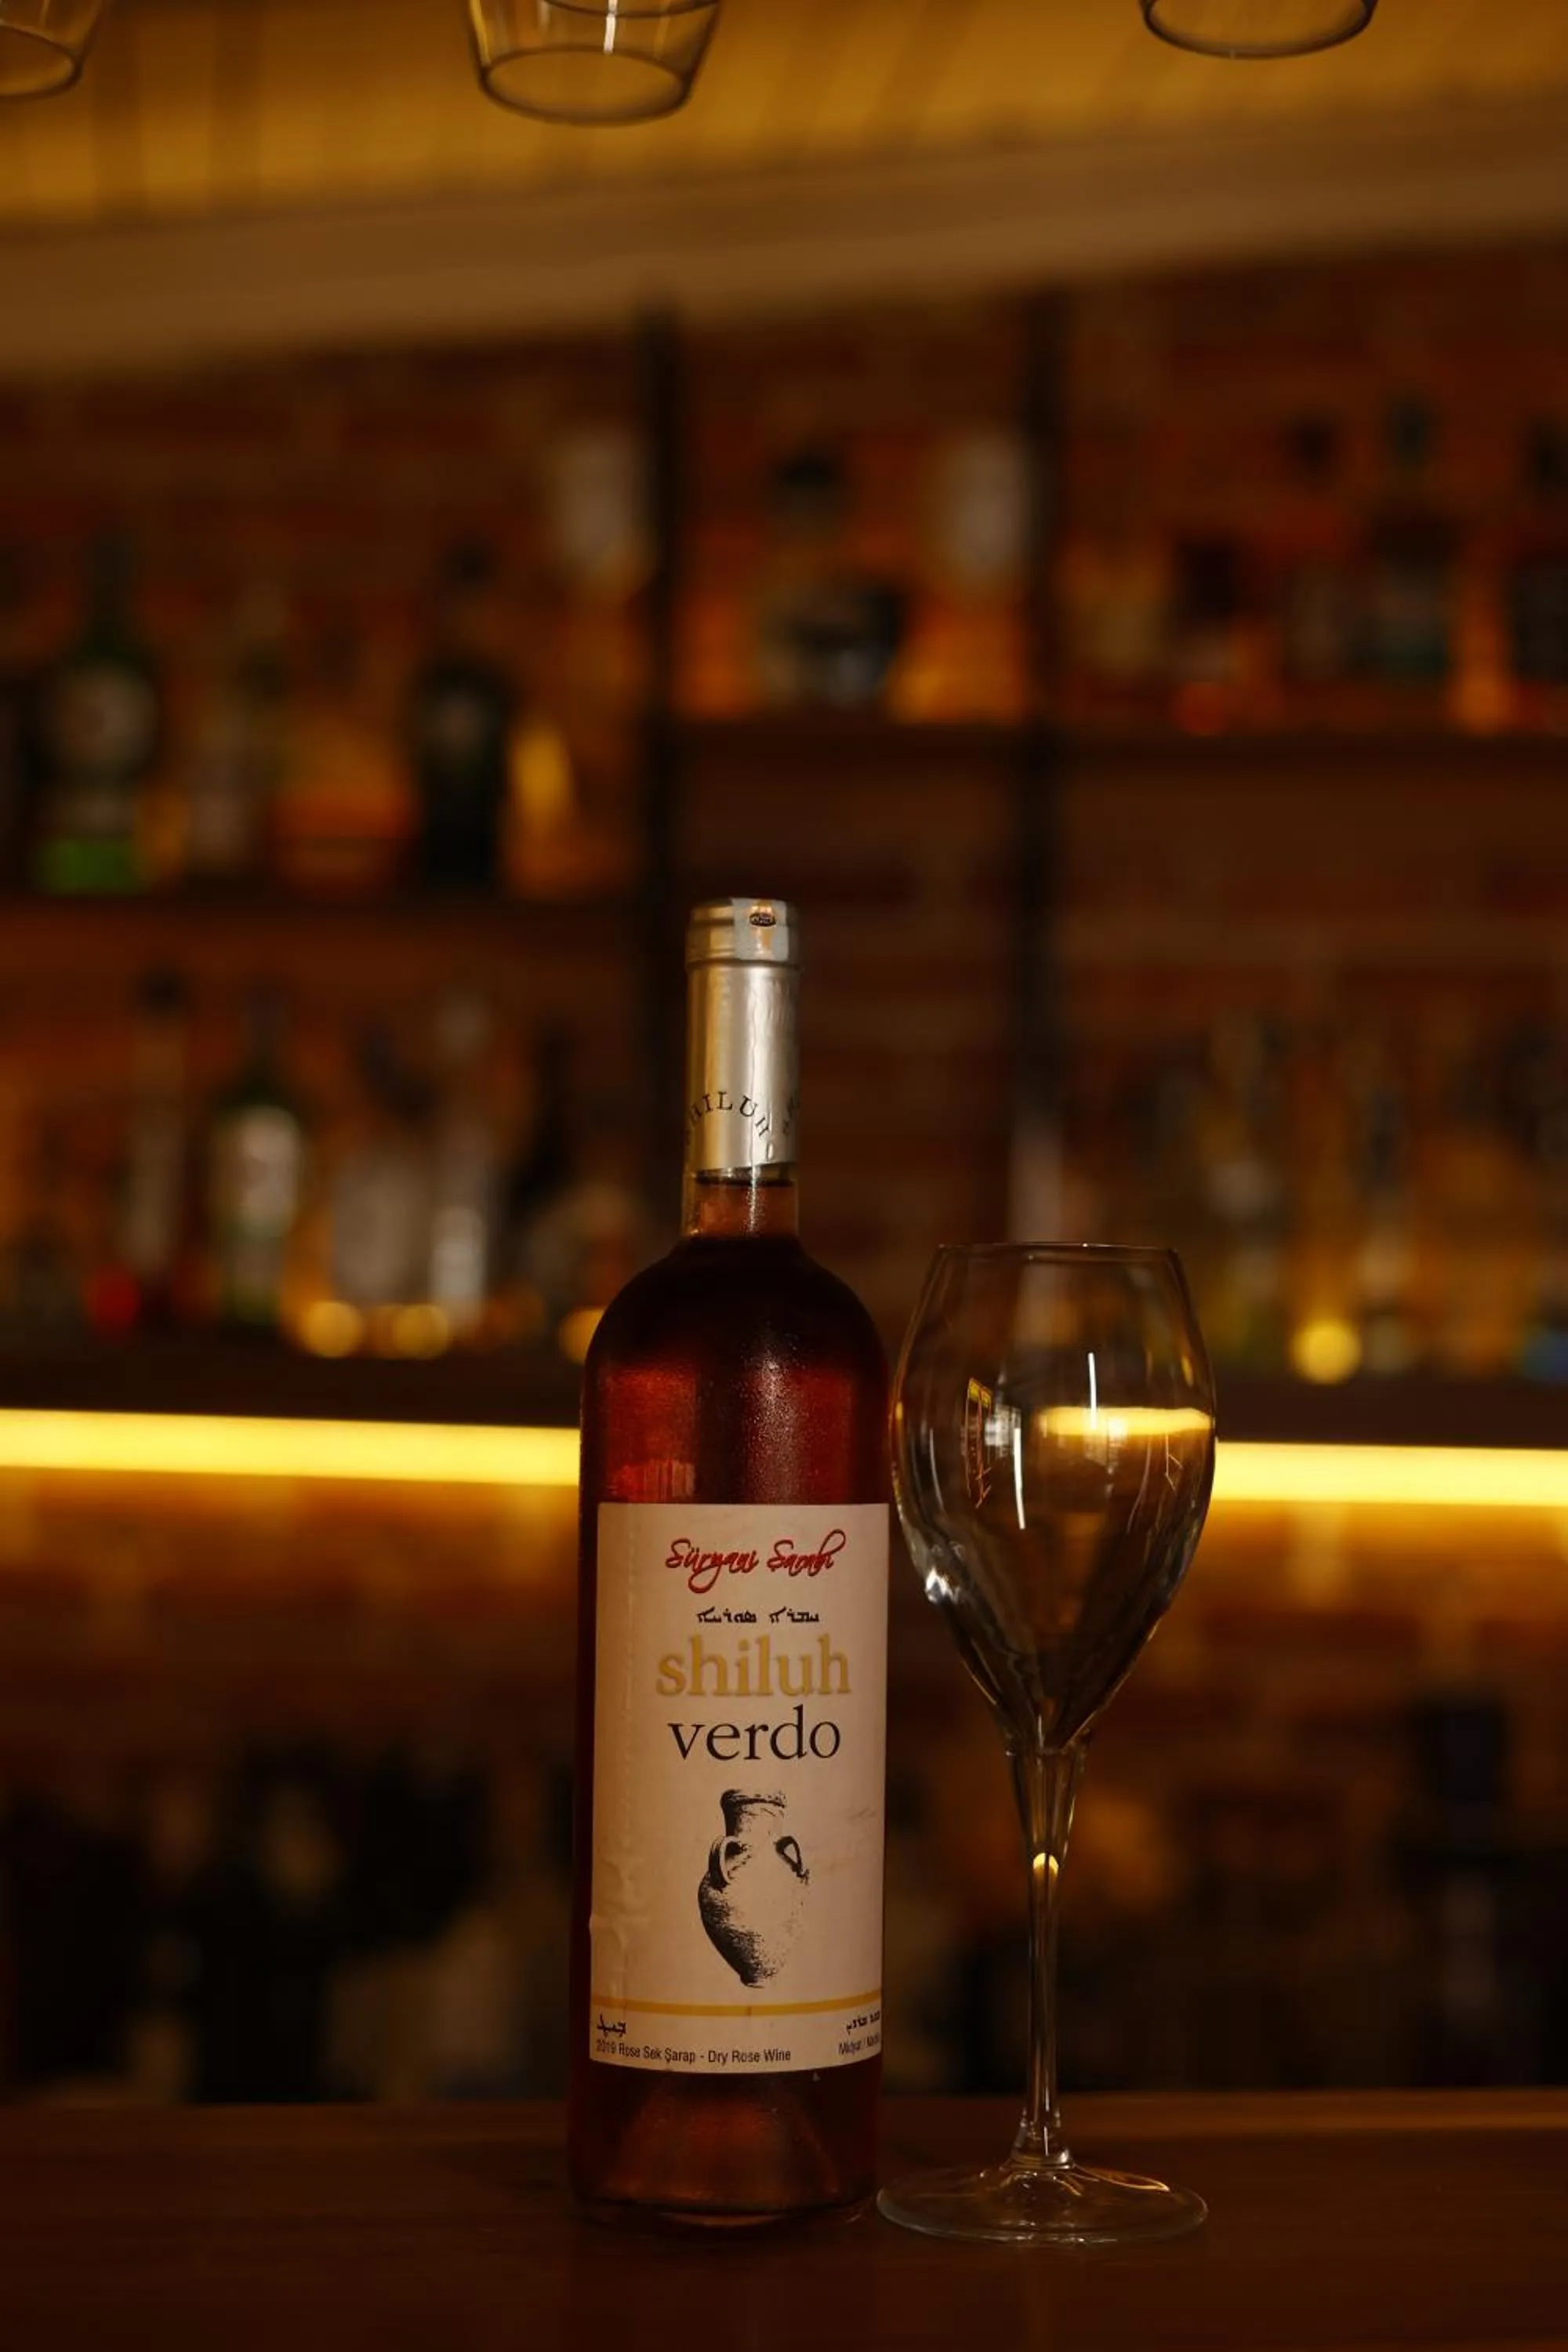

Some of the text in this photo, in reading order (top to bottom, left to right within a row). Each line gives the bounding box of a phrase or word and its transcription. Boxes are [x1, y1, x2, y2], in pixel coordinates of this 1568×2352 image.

[665, 1538, 759, 1593] Süryani
[655, 1634, 851, 1697] shiluh
[667, 1704, 840, 1760] verdo
[643, 2046, 662, 2060] Sek
[664, 2048, 696, 2065] Şarap
[708, 2050, 728, 2067] Dry
[732, 2051, 760, 2063] Rose
[764, 2049, 792, 2062] Wine
